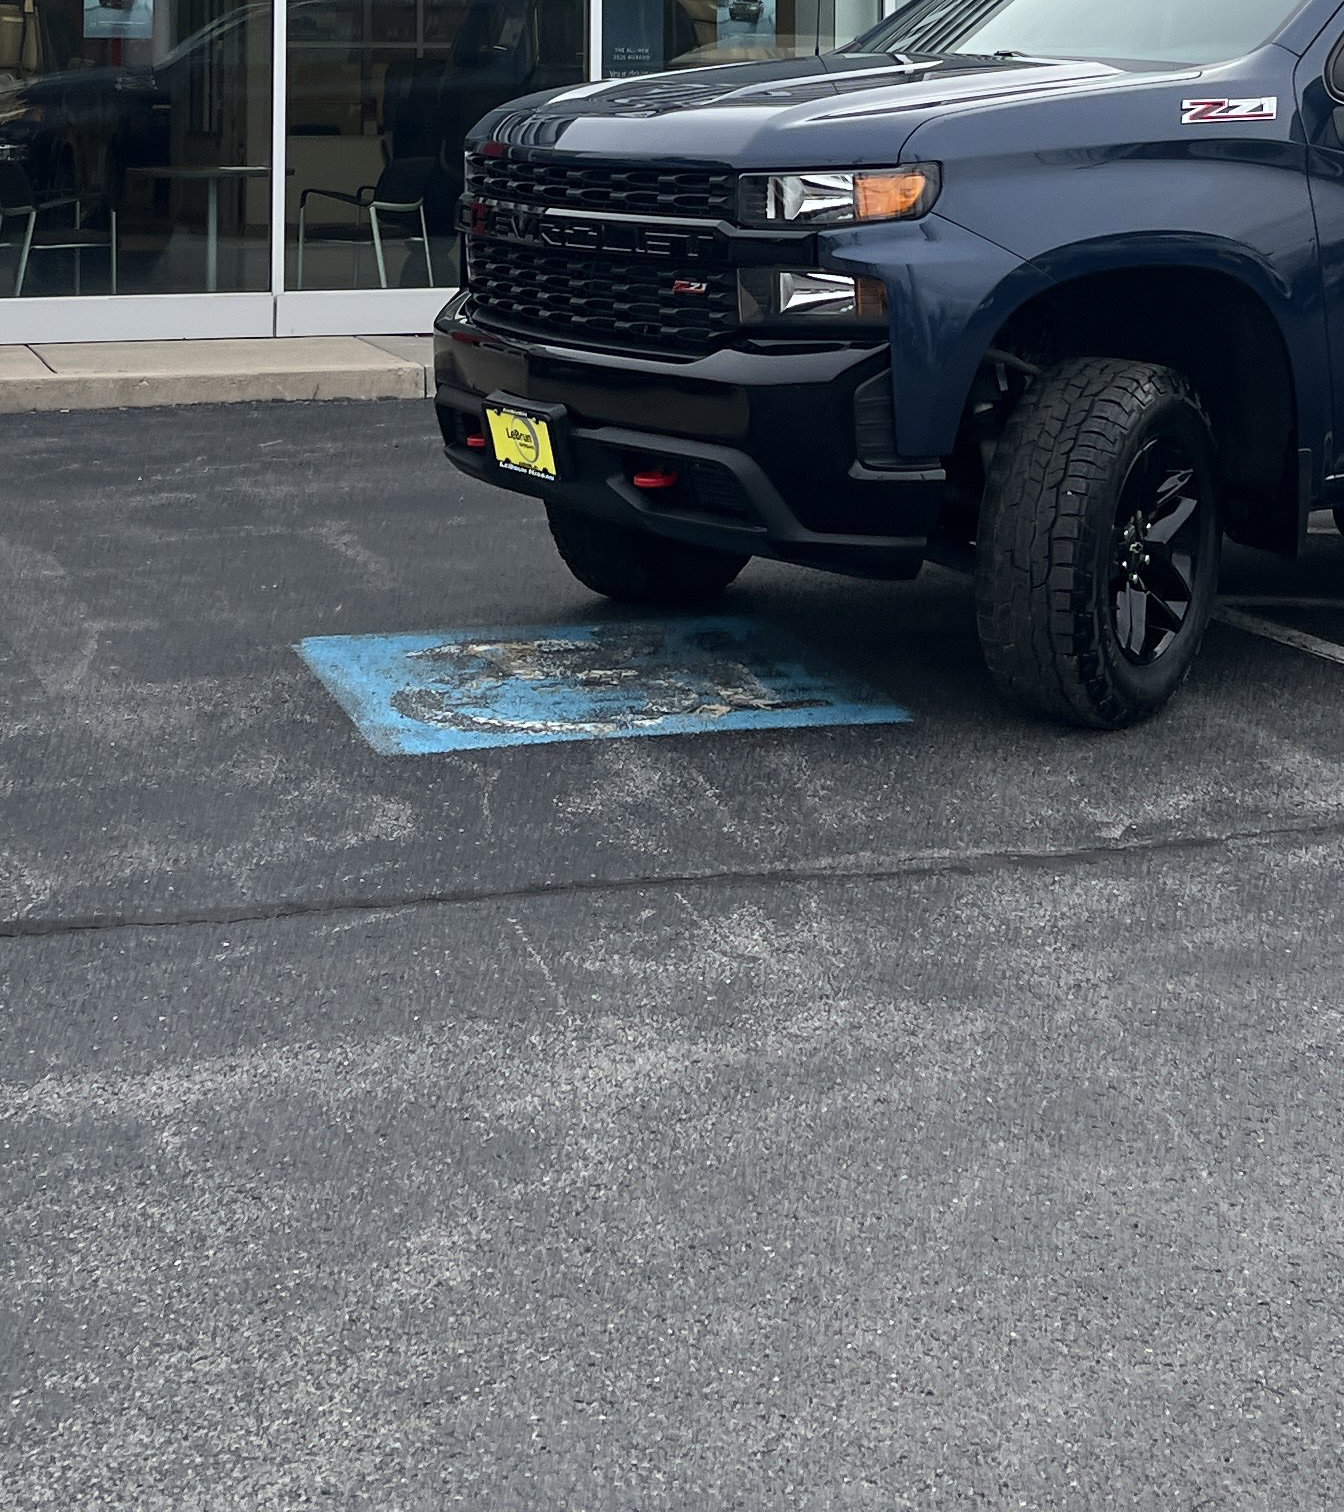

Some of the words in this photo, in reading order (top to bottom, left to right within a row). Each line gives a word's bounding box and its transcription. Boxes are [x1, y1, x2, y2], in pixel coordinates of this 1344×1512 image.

[1181, 96, 1278, 124] Z71
[672, 279, 708, 295] Z71
[506, 428, 532, 443] LeBrun
